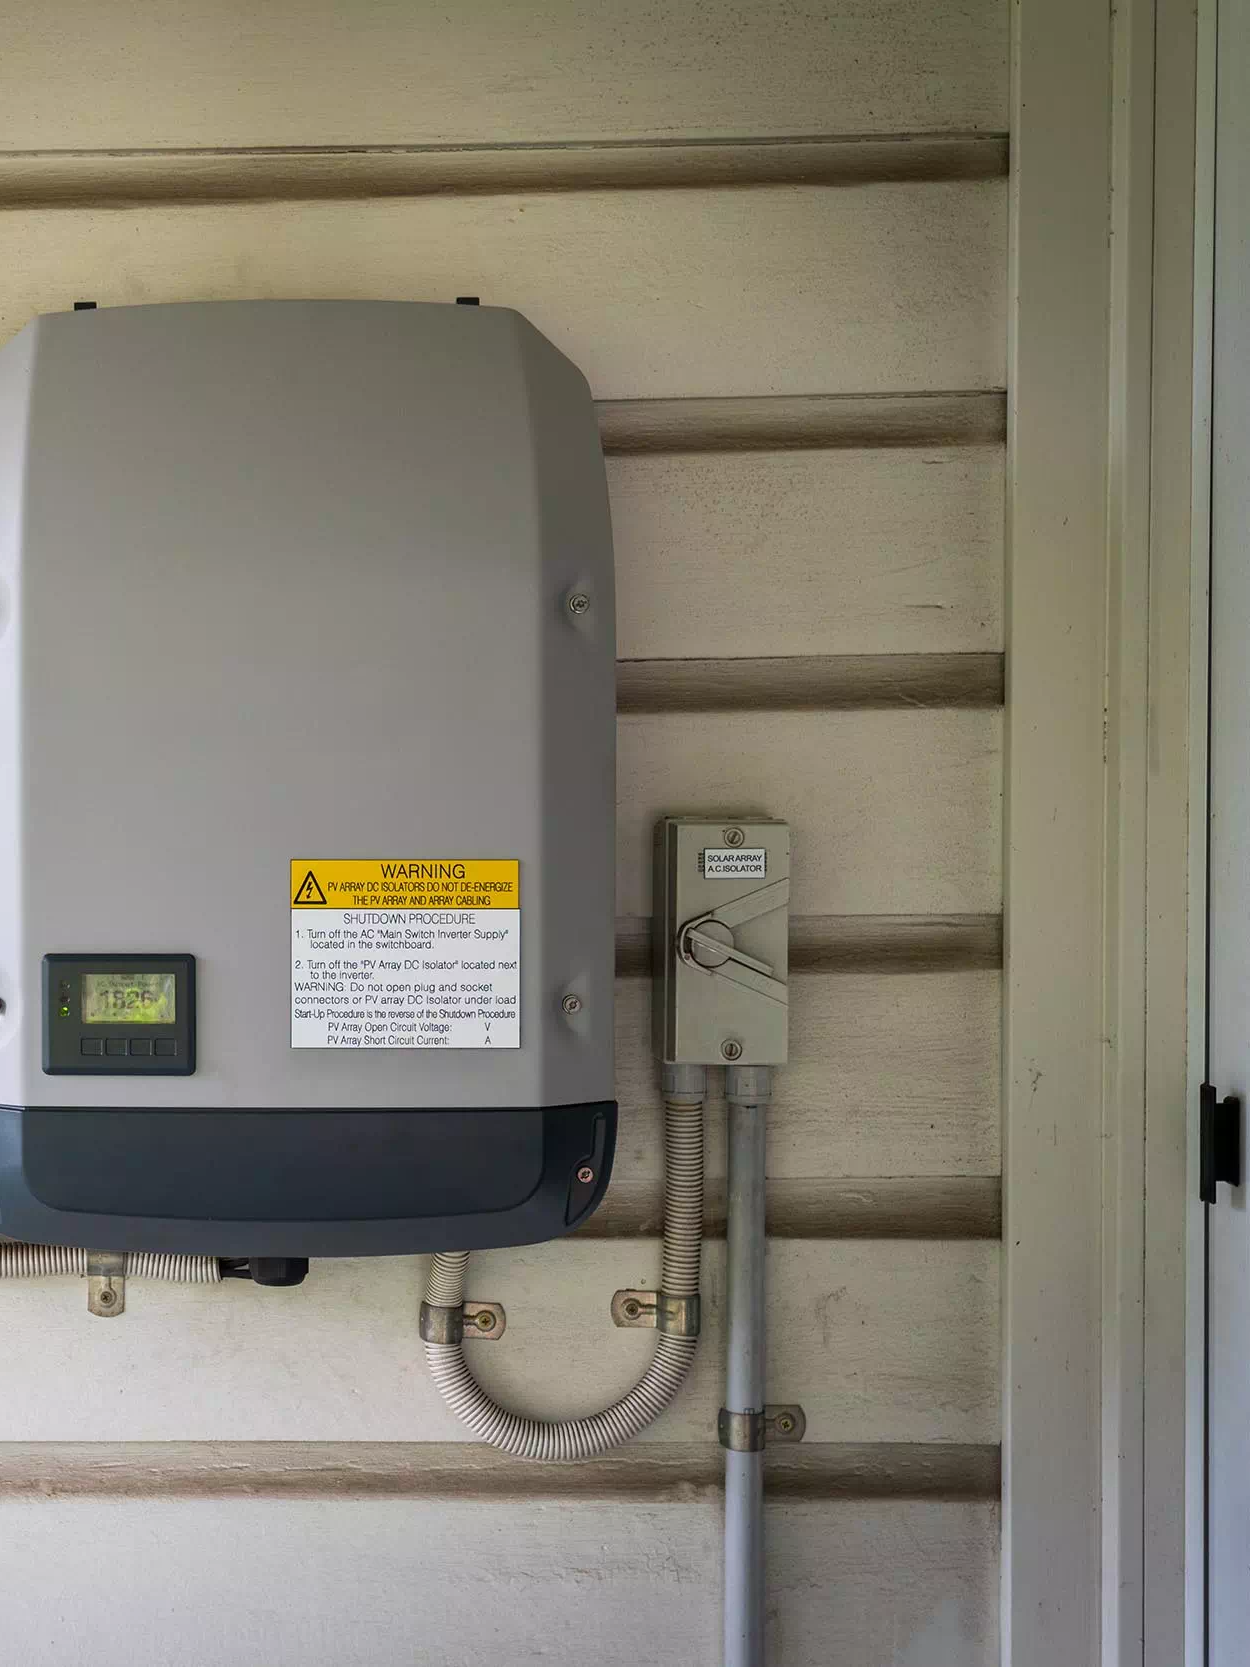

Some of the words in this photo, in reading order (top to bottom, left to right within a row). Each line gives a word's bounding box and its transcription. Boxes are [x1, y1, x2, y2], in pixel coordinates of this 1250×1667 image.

[707, 854, 735, 862] SOLAR
[735, 854, 762, 862] ARRAY
[380, 863, 466, 879] WARNING
[327, 881, 339, 893] PV
[339, 881, 366, 893] ARRAY
[366, 881, 380, 893] DC
[380, 881, 426, 893] ISOLATORS
[426, 881, 440, 893] DO
[441, 881, 459, 893] NOT
[460, 881, 514, 893] DE-ENERGIZE
[353, 895, 369, 906] THE
[370, 895, 381, 906] PV
[381, 895, 408, 906] ARRAY
[408, 895, 427, 906] AND
[428, 895, 454, 906] ARRAY
[455, 895, 491, 906] CABLING
[343, 912, 406, 925] SHUTDOWN
[409, 912, 476, 925] PROCEDURE
[296, 929, 304, 939] 1.
[307, 929, 326, 939] Turn
[328, 929, 341, 939] off
[343, 929, 358, 939] the
[360, 929, 375, 939] AC
[404, 929, 435, 939] Switch
[437, 929, 472, 939] Inverter
[310, 940, 345, 949] located
[347, 940, 356, 949] in
[358, 940, 373, 949] the
[375, 940, 435, 949] switchboard.
[294, 960, 304, 970] 2.
[307, 960, 326, 970] Turn
[328, 960, 341, 970] off
[343, 960, 358, 970] the
[378, 960, 402, 972] Array
[404, 960, 420, 970] DC
[461, 960, 496, 970] located
[498, 960, 518, 970] next
[310, 971, 320, 980] to
[322, 971, 337, 980] the
[350, 981, 365, 992] Do
[367, 981, 384, 992] not
[385, 983, 411, 994] open
[414, 982, 436, 994] plug
[438, 981, 458, 992] and
[460, 981, 493, 992] socket
[294, 994, 350, 1005] connectors
[352, 994, 362, 1005] or
[364, 994, 379, 1005] PV
[380, 996, 405, 1007] array
[407, 994, 424, 1005] DC
[464, 994, 493, 1005] under
[495, 994, 517, 1005] load
[294, 1008, 326, 1020] Start-Up
[326, 1008, 365, 1019] Procedure
[366, 1008, 373, 1019] is
[374, 1008, 387, 1019] the
[388, 1008, 415, 1019] reverse
[416, 1008, 425, 1019] of
[425, 1008, 438, 1019] the
[438, 1008, 477, 1019] Shutdown
[477, 1008, 517, 1019] Procedure
[327, 1022, 340, 1032] PV
[341, 1022, 363, 1034] Array
[364, 1022, 388, 1033] Open
[389, 1022, 418, 1032] Circuit
[418, 1022, 453, 1034] Voltage:
[484, 1022, 491, 1032] V
[327, 1035, 339, 1046] PV
[340, 1035, 362, 1047] Array
[363, 1035, 386, 1046] Short
[387, 1035, 415, 1046] Circuit
[416, 1035, 450, 1046] Current:
[484, 1036, 492, 1045] A
